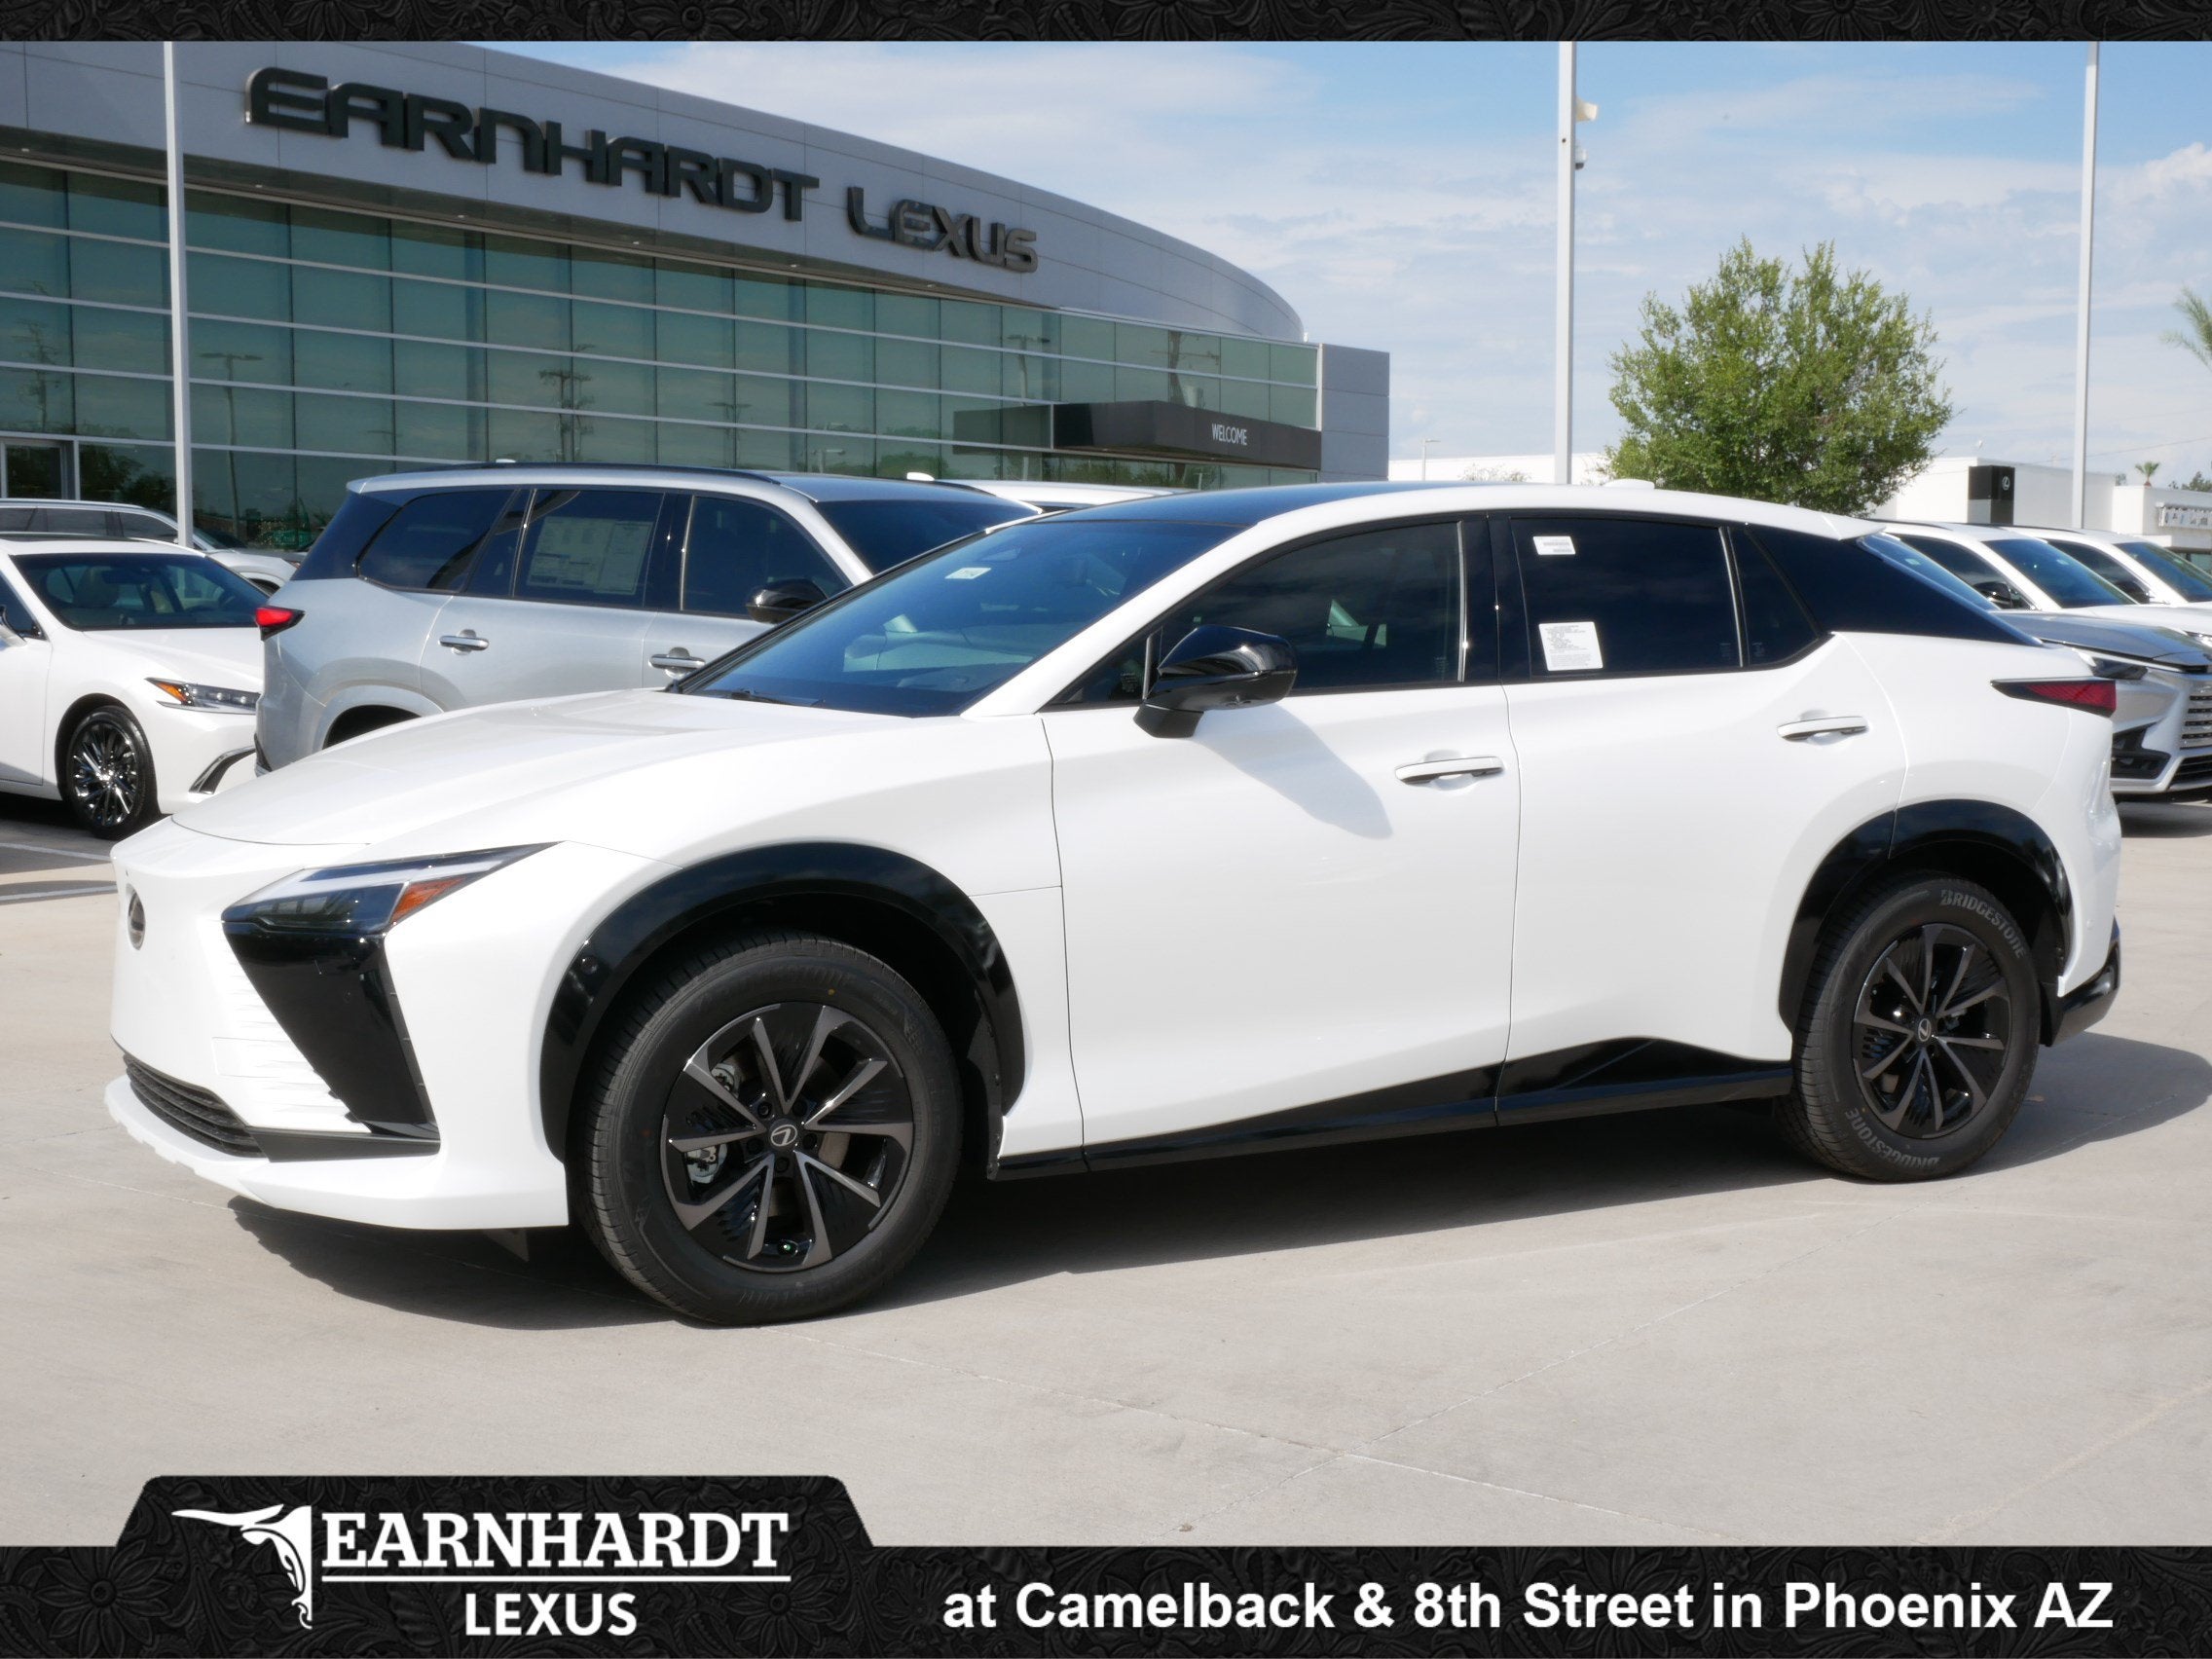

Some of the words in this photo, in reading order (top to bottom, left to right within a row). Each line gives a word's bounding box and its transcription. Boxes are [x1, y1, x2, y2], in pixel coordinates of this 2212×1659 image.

[245, 66, 820, 222] EARNHARDT
[847, 186, 1039, 274] LEXUS
[1211, 423, 1248, 446] WELCOME
[1939, 888, 2026, 960] BRIDGESTONE
